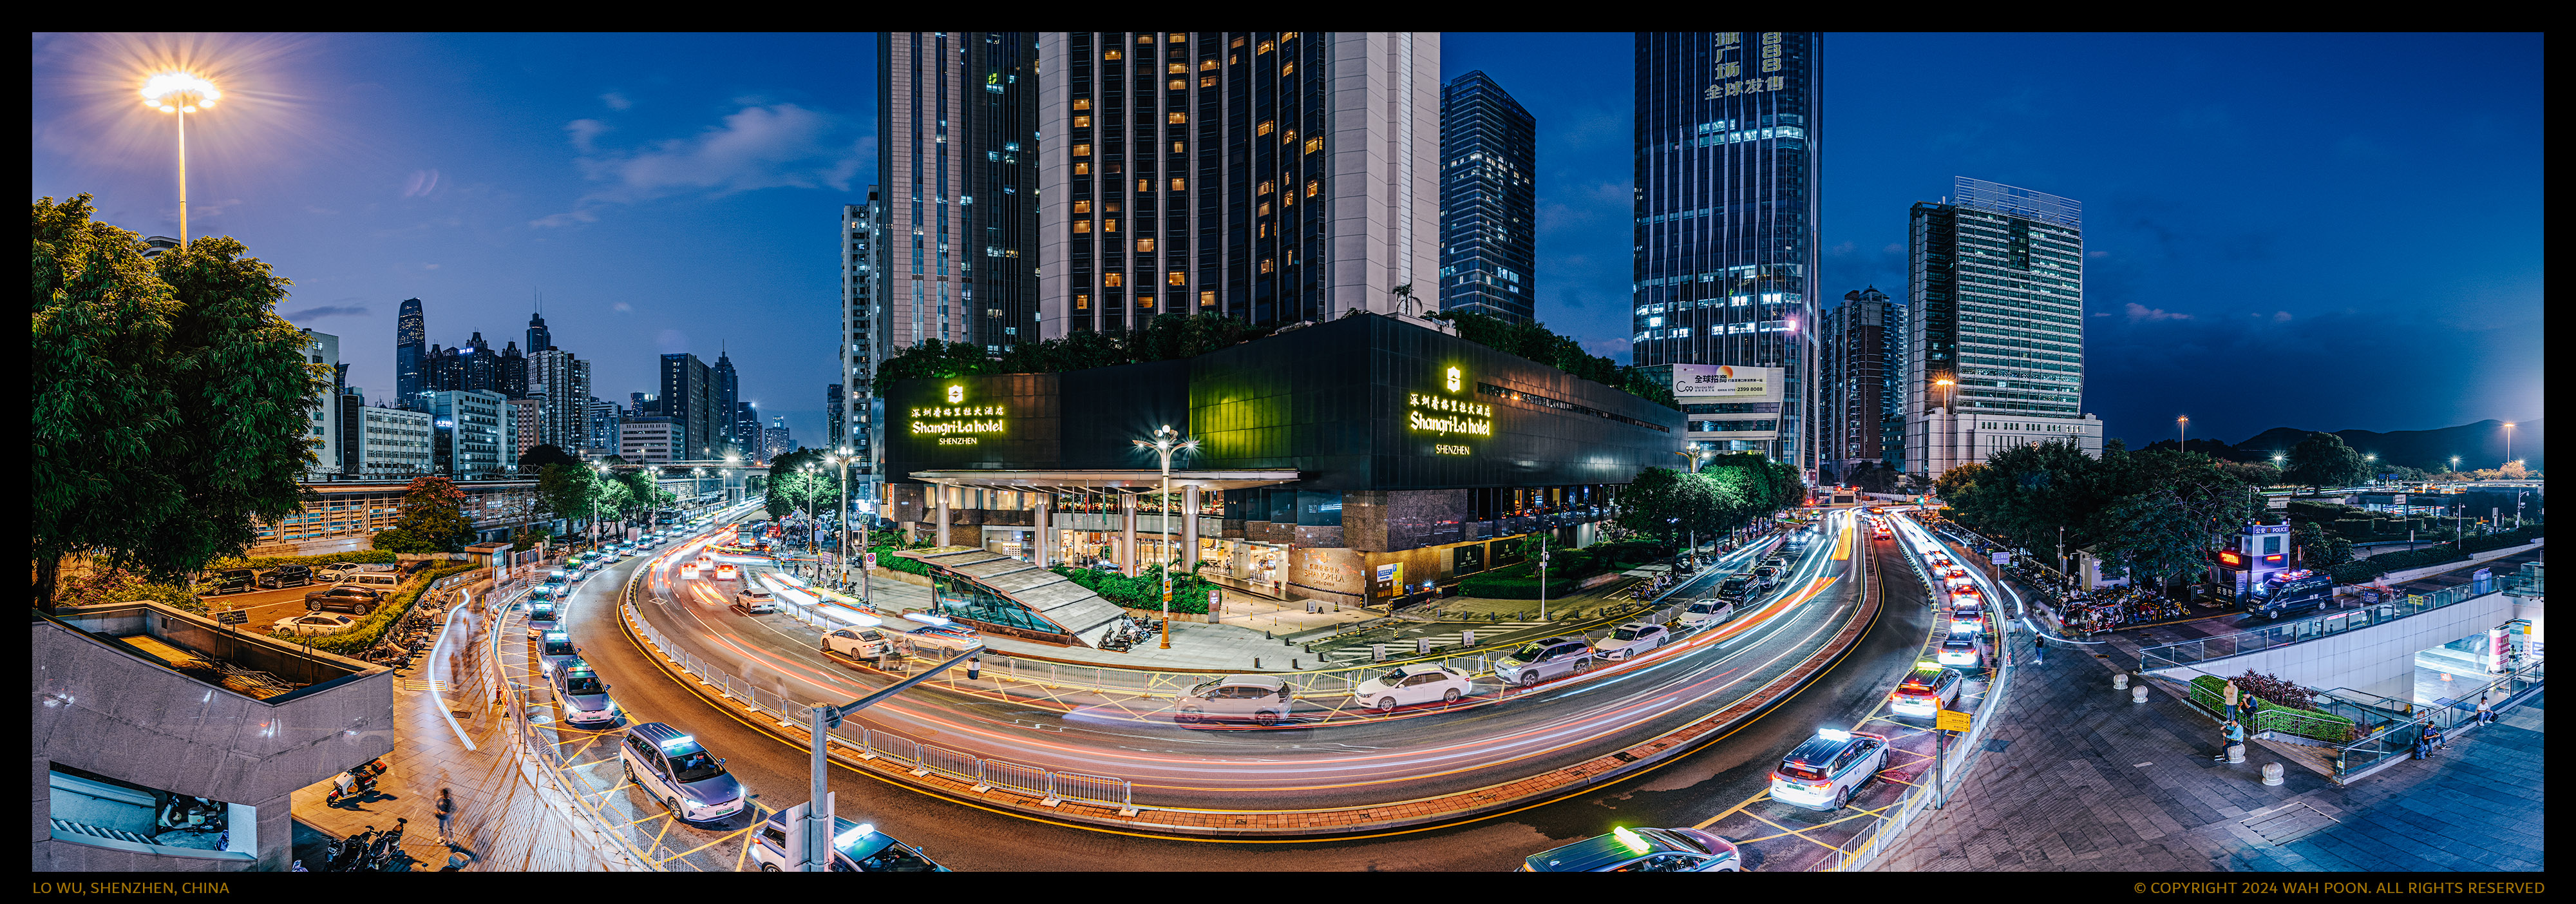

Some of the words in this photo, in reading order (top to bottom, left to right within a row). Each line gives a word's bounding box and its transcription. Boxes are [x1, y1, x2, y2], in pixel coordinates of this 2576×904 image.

[1704, 76, 1784, 101] 全球发售
[1694, 375, 1727, 383] 全球招商
[911, 406, 1004, 418] 深圳香格里拉大酒店
[1410, 393, 1491, 418] 深圳香格里拉大酒店
[974, 419, 1003, 433] hotel
[1468, 417, 1490, 436] hotel
[939, 437, 978, 445] SHENZHEN
[1435, 444, 1470, 455] SHENZHEN
[1304, 569, 1345, 583] SHANGRI-LA
